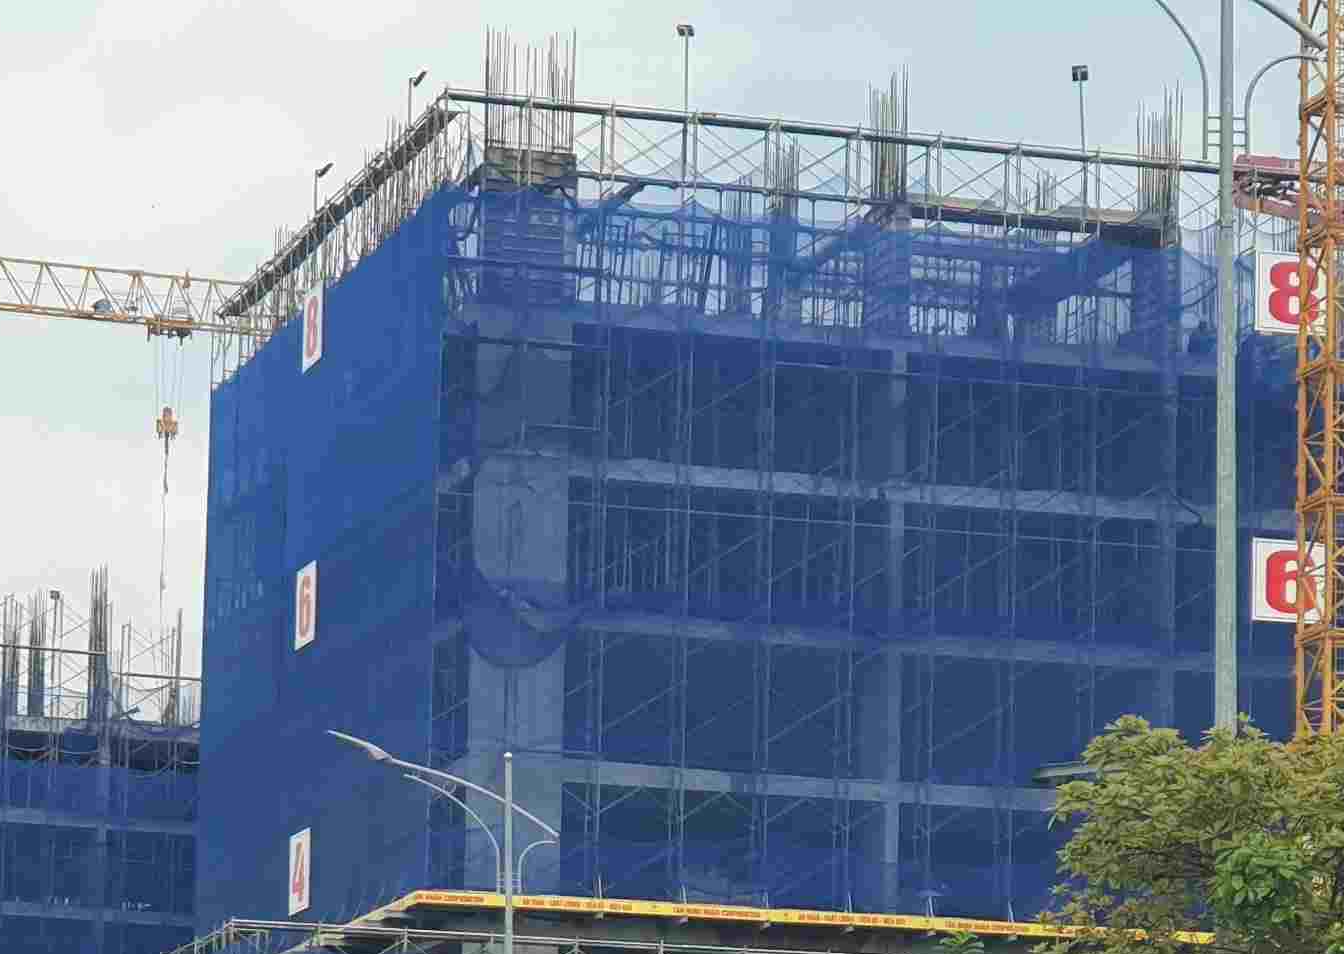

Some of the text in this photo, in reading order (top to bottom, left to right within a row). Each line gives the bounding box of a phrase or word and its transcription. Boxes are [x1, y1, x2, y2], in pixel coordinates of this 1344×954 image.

[1268, 261, 1319, 324] 8
[299, 576, 311, 637] 6
[1265, 550, 1317, 614] 6
[291, 841, 304, 898] 4
